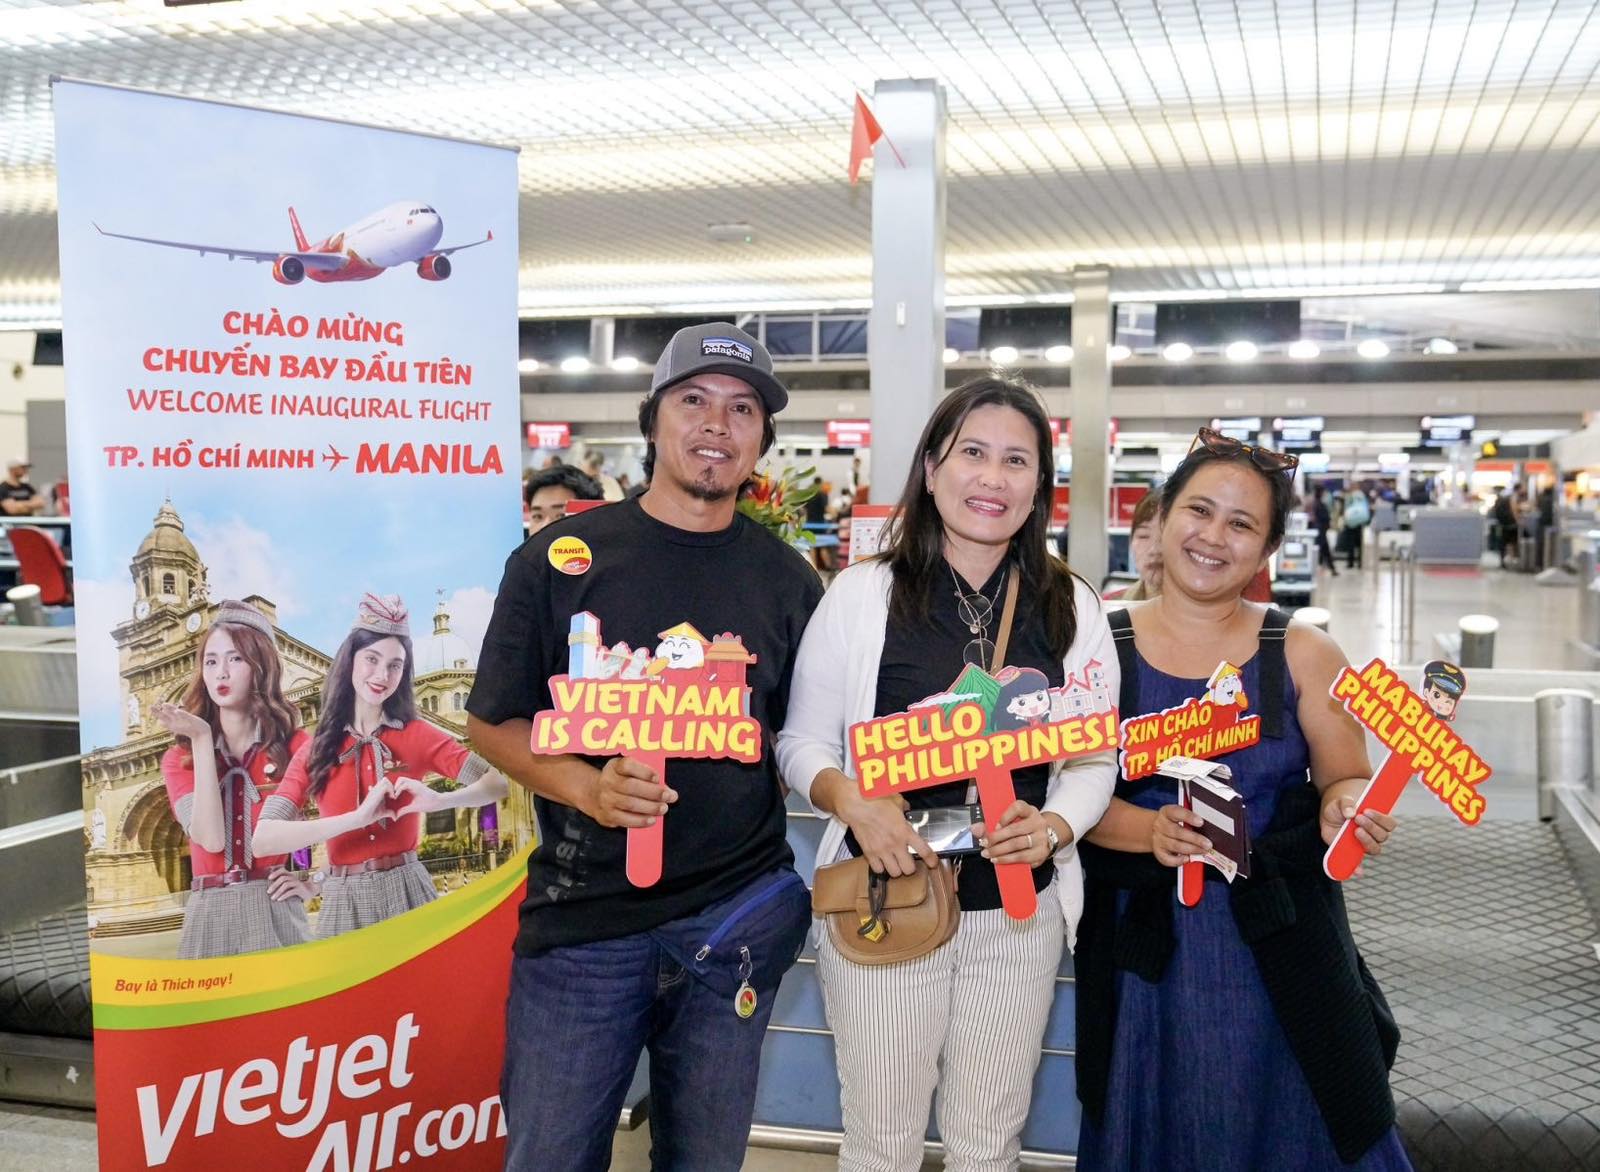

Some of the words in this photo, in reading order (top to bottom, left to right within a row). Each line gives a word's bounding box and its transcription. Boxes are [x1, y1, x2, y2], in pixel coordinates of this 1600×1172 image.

[223, 308, 309, 338] CHÀO
[316, 312, 404, 346] MỪNG
[142, 342, 270, 377] CHUYẾN
[279, 355, 339, 380] BAY
[345, 350, 406, 383] ĐẦU
[413, 358, 473, 386] TIÊN
[704, 347, 751, 362] patagonia
[127, 388, 262, 415] WELCOME
[271, 394, 412, 420] INAUGURAL
[418, 399, 492, 423] FLIGHT
[103, 446, 145, 468] TP.
[152, 438, 193, 468] HỒ
[198, 441, 241, 469] CHÍ
[246, 447, 314, 469] MINH
[355, 442, 504, 475] MANILA
[555, 681, 741, 717] VIETNAM
[538, 717, 570, 750] IS
[581, 718, 756, 757] CALLING
[854, 705, 983, 758] HELLO
[1127, 719, 1160, 746] XIN
[1163, 703, 1212, 736] CHÀO
[1361, 662, 1488, 783] MABUHAY
[859, 714, 1118, 791] PHILIPPINES!
[1127, 751, 1152, 776] TP.
[1156, 734, 1183, 768] HỒ
[1184, 727, 1213, 760] CHÍ
[1214, 719, 1258, 750] MINH
[1335, 672, 1483, 821] PHILIPPINES
[115, 979, 142, 994] Bay
[145, 979, 158, 992] là
[198, 972, 233, 990] ngay!
[136, 1012, 420, 1168] Vietjet
